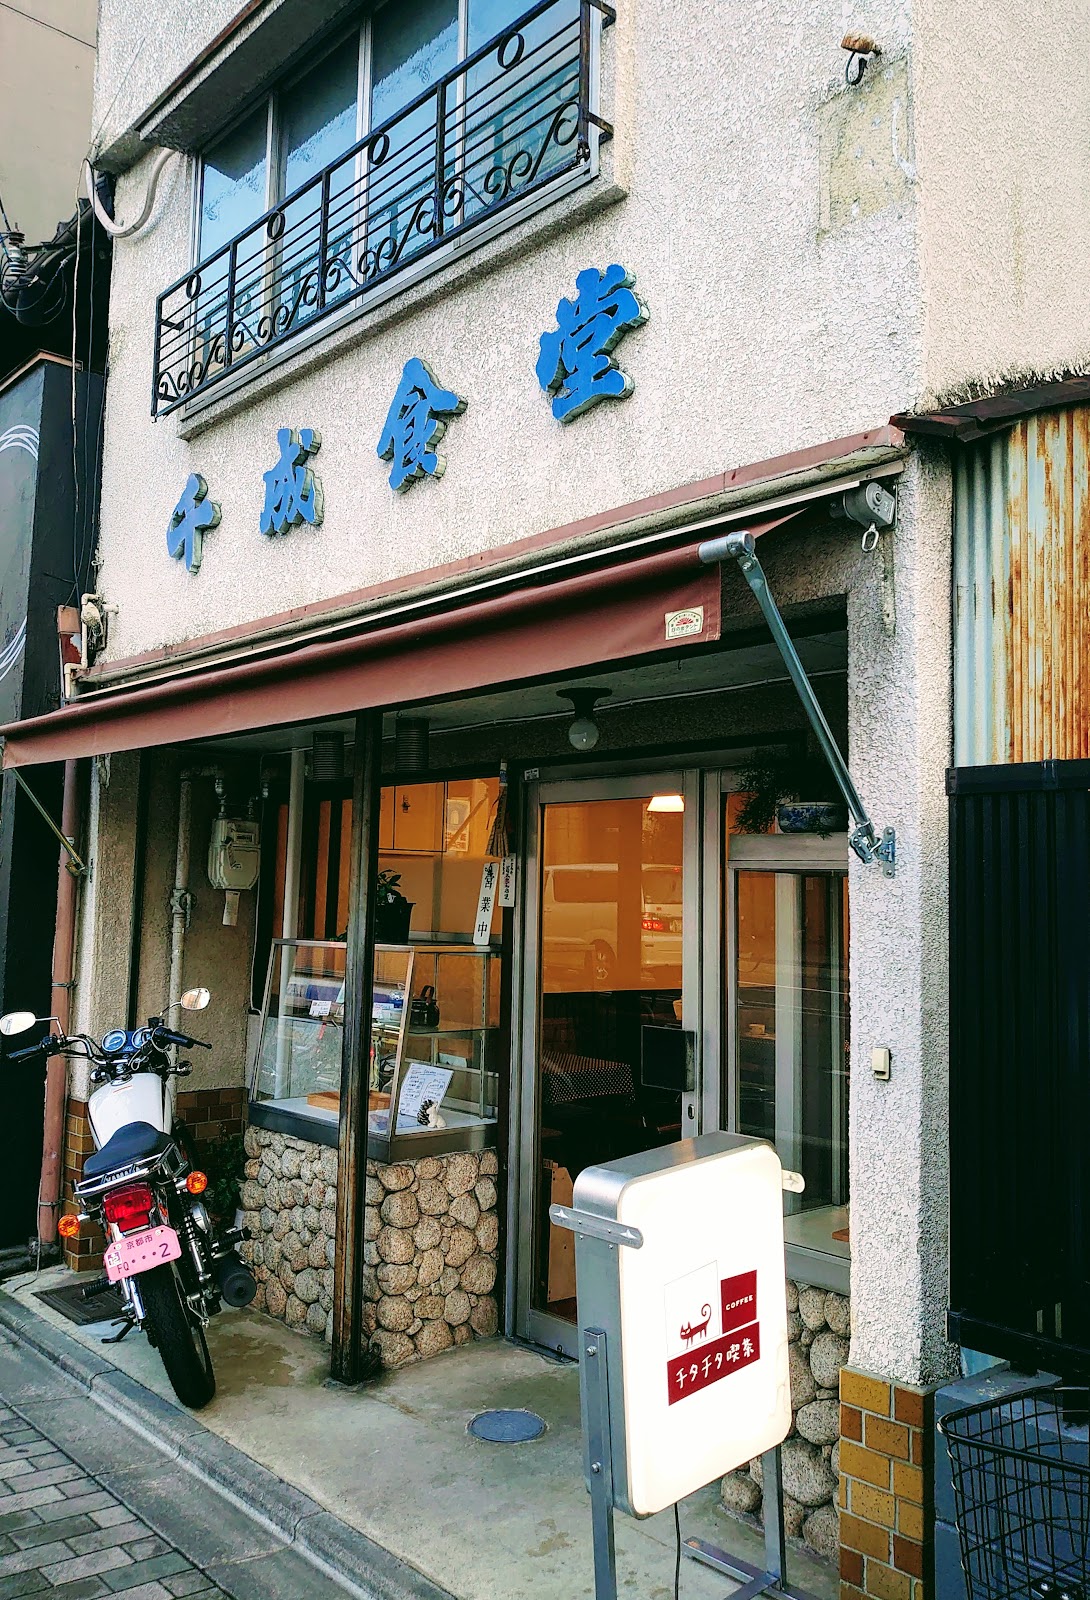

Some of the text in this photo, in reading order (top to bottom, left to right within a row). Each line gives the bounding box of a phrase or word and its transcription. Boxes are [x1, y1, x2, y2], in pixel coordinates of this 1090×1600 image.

[166, 263, 649, 573] 千成食堂
[477, 866, 495, 937] 営業中
[126, 1234, 153, 1250] 京都市
[725, 1294, 754, 1311] COFFEE
[675, 1337, 755, 1389] チタチタ喫茶
